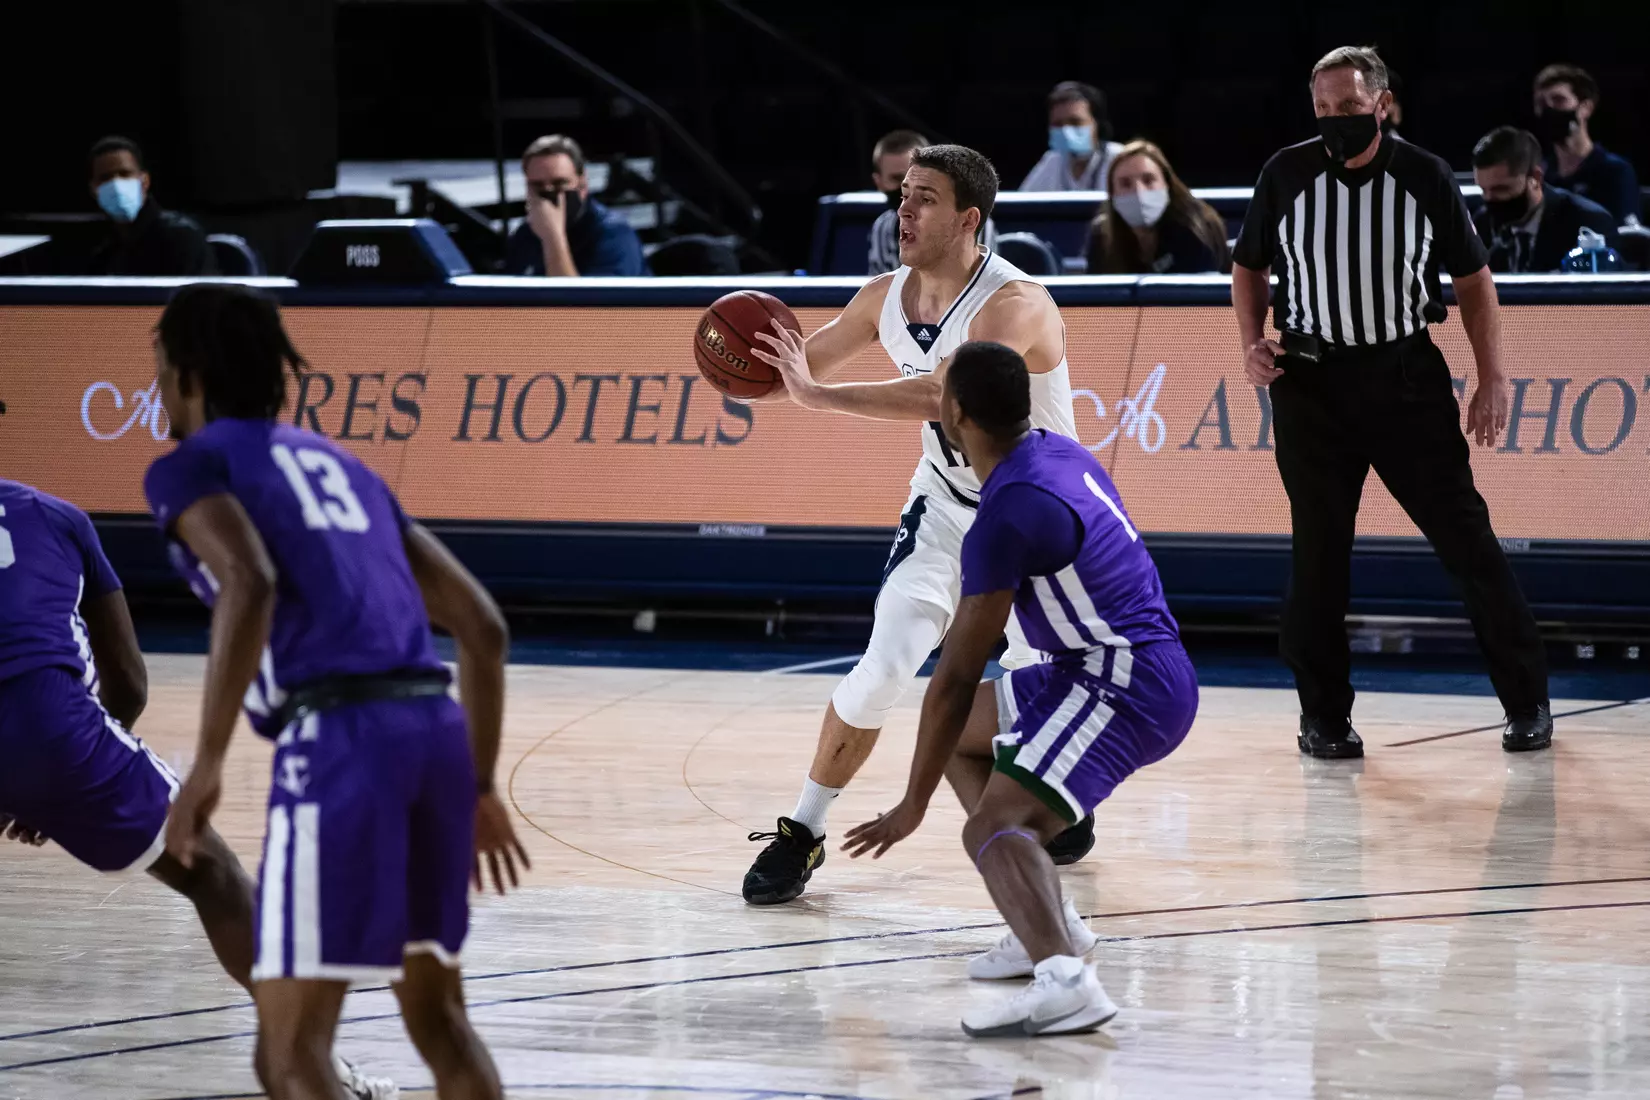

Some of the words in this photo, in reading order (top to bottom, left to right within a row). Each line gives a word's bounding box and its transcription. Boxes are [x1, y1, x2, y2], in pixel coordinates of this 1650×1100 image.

[346, 244, 381, 267] POSS
[451, 372, 754, 448] HOTELS
[270, 444, 370, 534] 13
